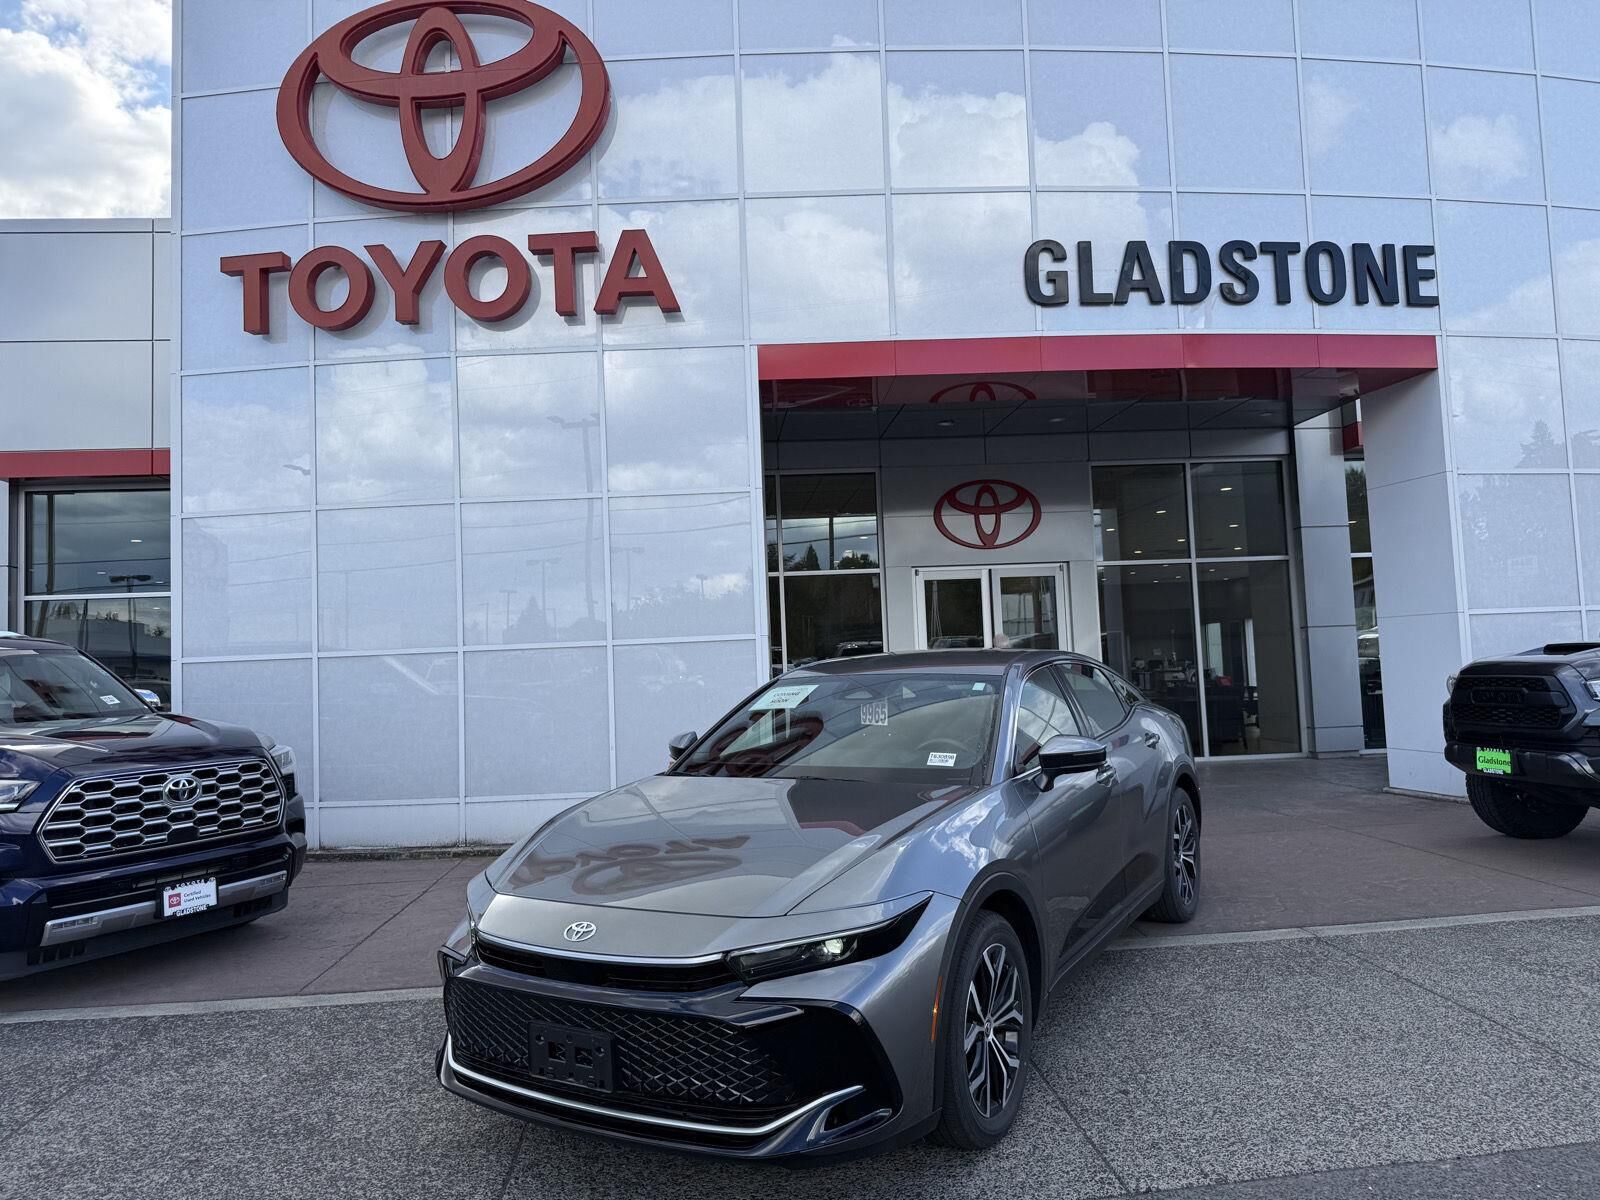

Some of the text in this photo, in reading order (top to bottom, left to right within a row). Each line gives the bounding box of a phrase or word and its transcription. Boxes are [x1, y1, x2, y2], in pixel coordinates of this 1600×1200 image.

[1024, 239, 1440, 307] GLADSTONE
[220, 229, 681, 336] TOYOTA
[861, 701, 887, 724] 9965
[1477, 755, 1512, 766] Gladstone
[176, 879, 205, 888] TOYOTA
[176, 904, 208, 917] GLADSTONE
